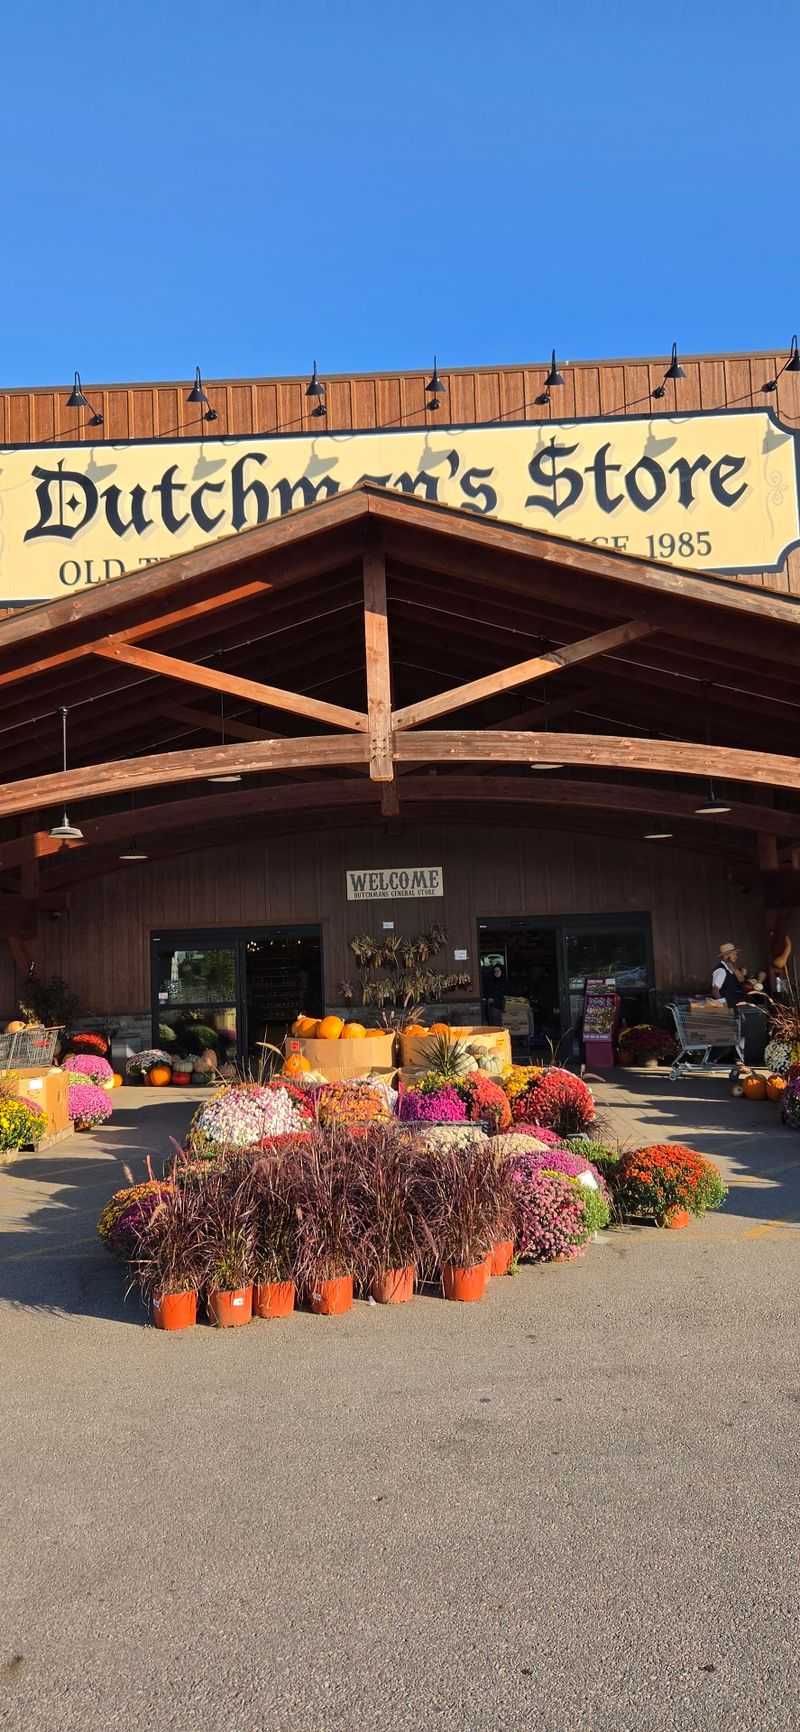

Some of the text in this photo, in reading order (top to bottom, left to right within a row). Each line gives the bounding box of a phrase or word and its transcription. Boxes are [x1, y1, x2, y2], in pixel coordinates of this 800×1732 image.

[525, 435, 749, 518] Store
[59, 559, 125, 586] OLD
[646, 531, 712, 559] 1985
[350, 870, 439, 891] WELCOME
[390, 889, 415, 897] GENERAL
